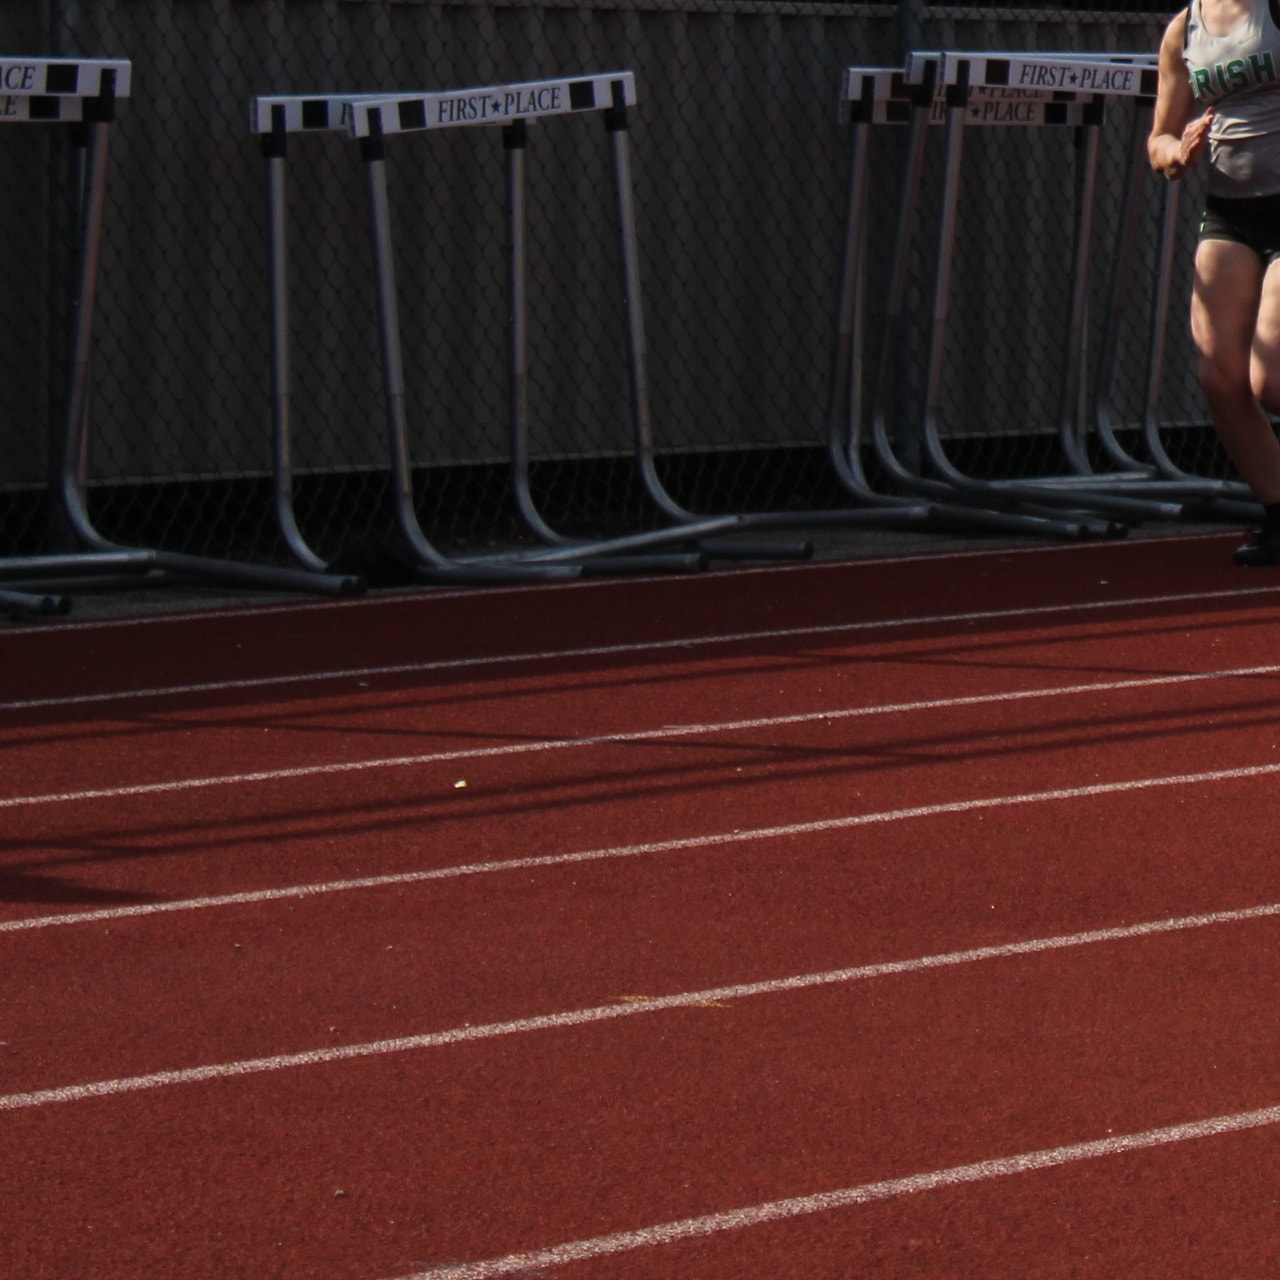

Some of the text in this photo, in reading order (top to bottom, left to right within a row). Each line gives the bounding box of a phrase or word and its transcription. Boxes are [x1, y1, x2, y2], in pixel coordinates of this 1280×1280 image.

[1019, 63, 1134, 91] FIRST PLACE
[1192, 51, 1277, 100] RISH
[438, 87, 562, 123] FIRST PLACE
[982, 102, 1038, 122] PLACE
